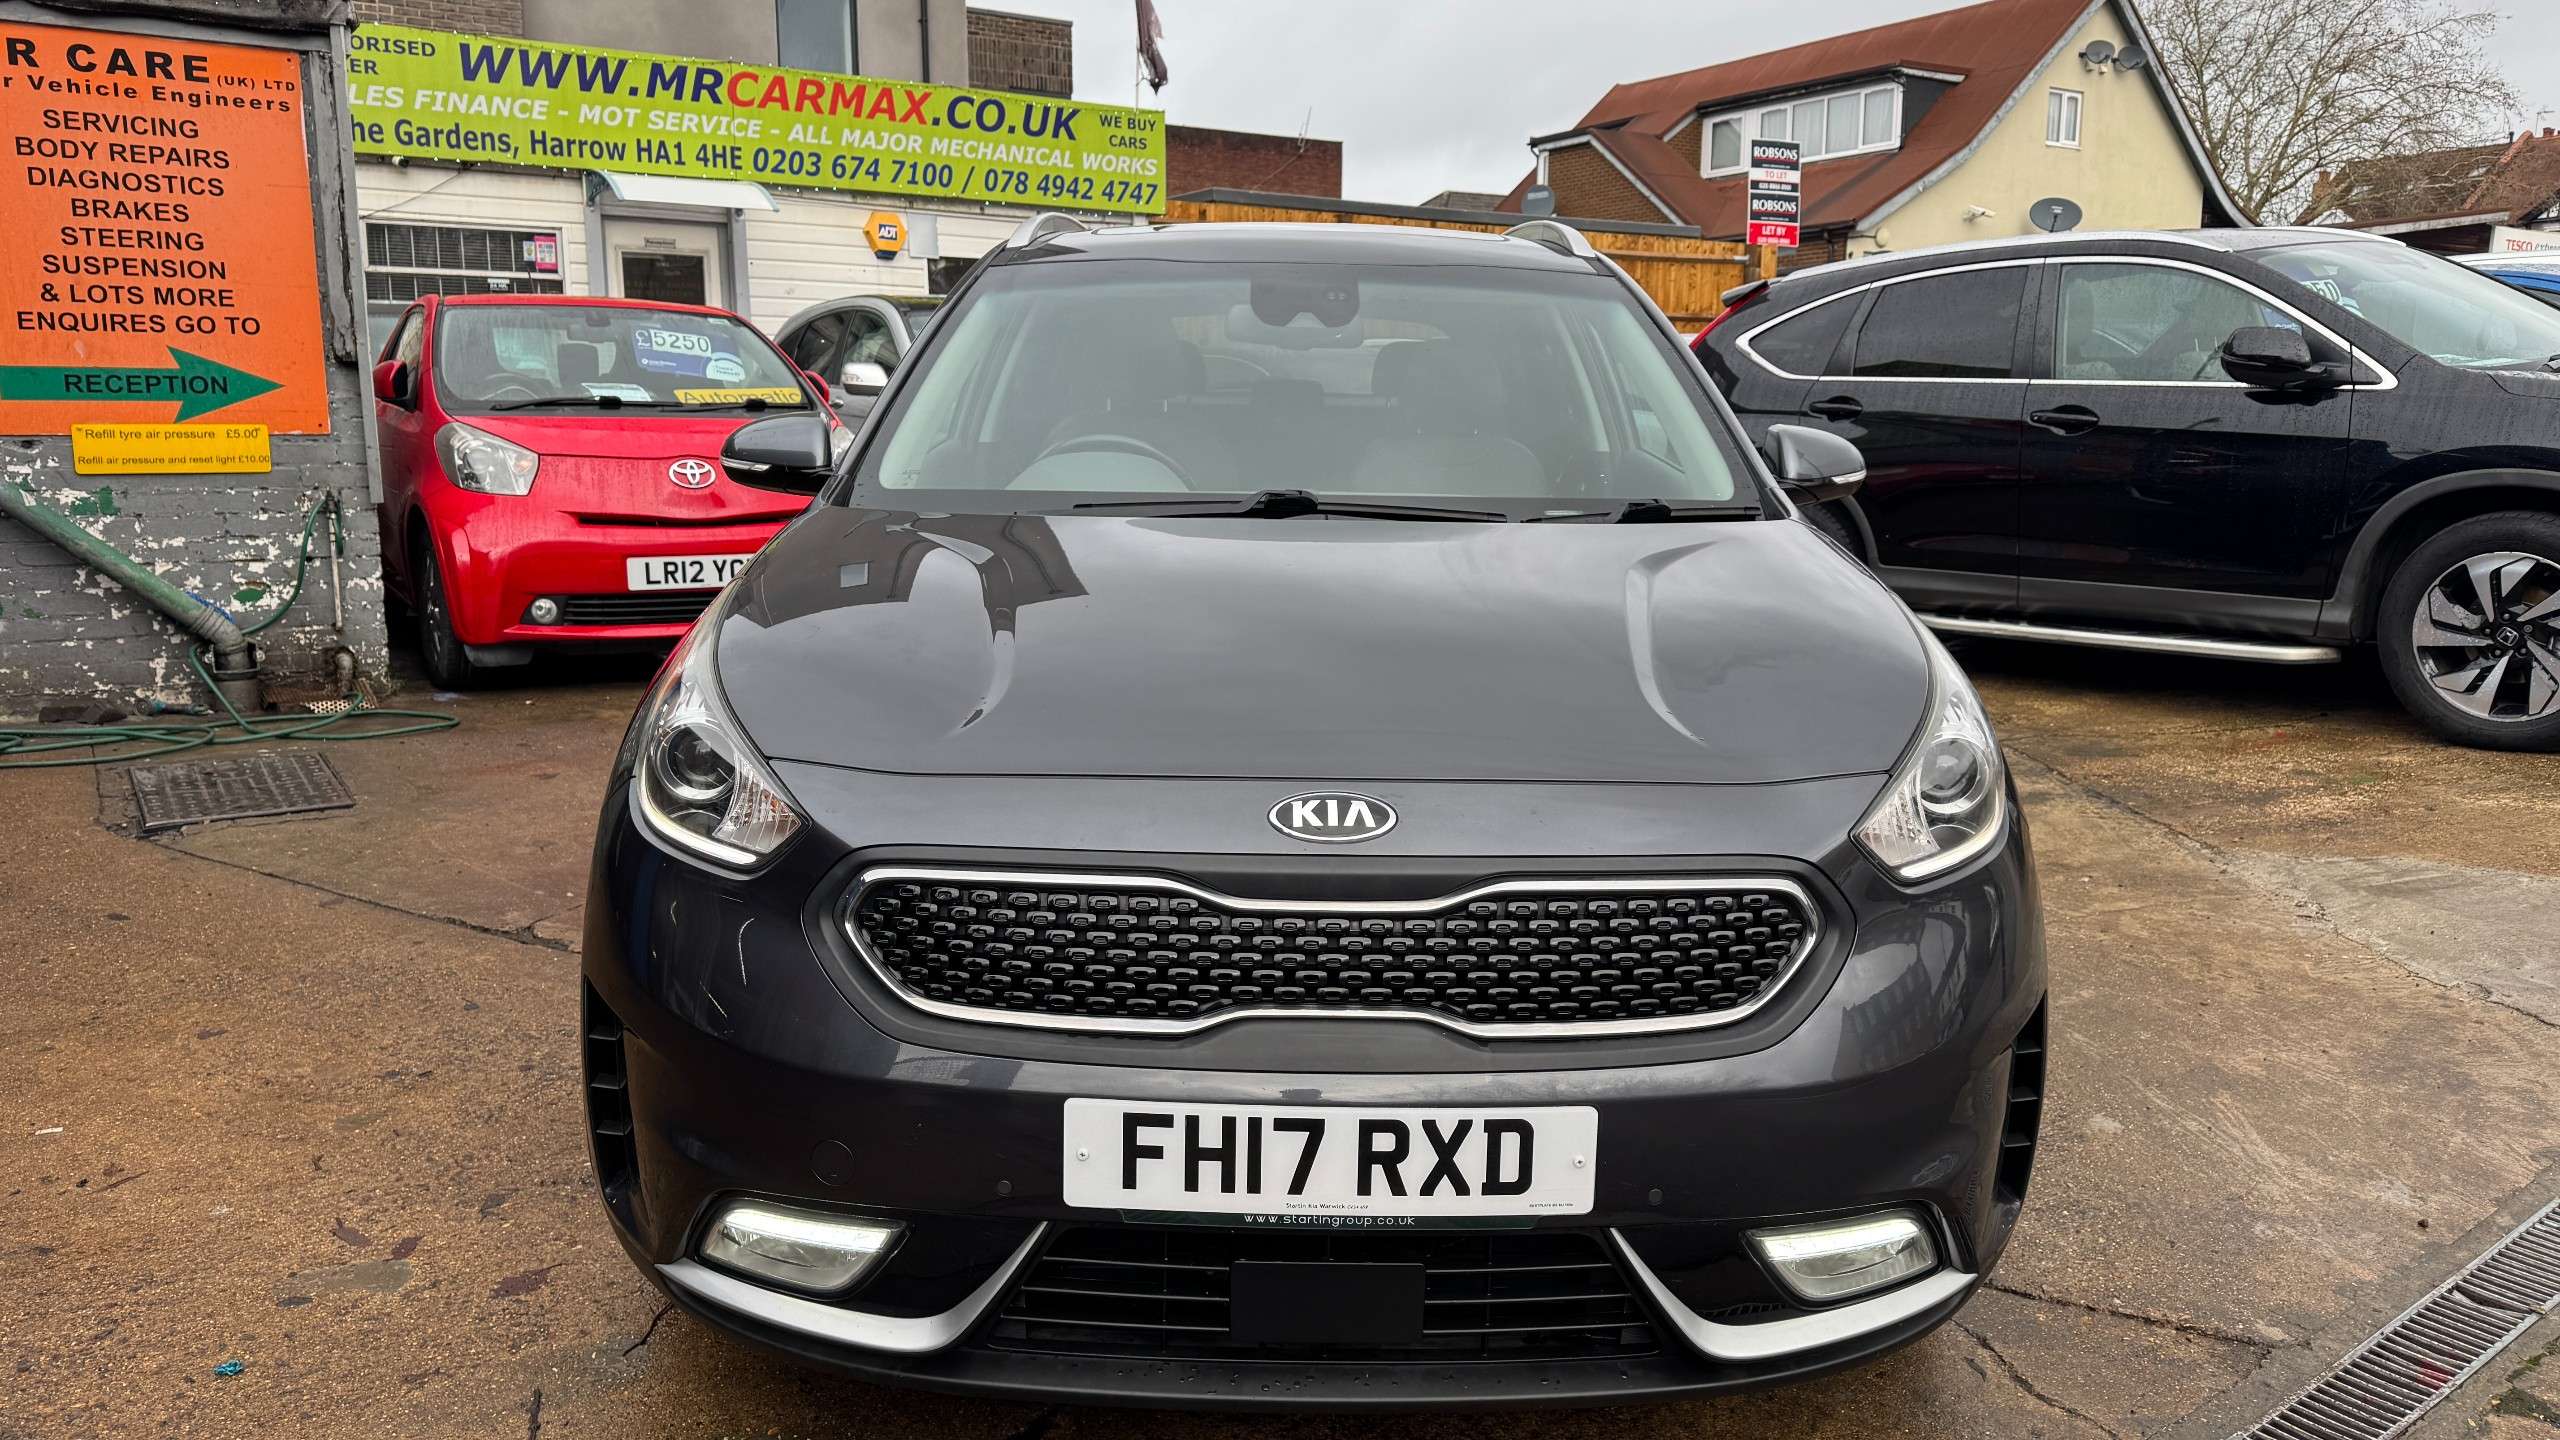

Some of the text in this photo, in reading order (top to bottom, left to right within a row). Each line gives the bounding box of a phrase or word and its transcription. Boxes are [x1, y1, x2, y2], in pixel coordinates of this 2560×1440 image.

[351, 35, 436, 57] ORISED
[66, 44, 210, 83] CARE
[216, 75, 256, 89] (UK)
[263, 79, 296, 92] LTD
[27, 74, 138, 99] Vehicle
[152, 86, 291, 113] Engineers
[458, 42, 1081, 141] WWW.MRCARMAX.CO.UK
[42, 108, 200, 139] SERVICING
[348, 83, 404, 109] LES
[414, 89, 549, 121] FINANCE
[578, 104, 641, 129] MOT
[648, 111, 762, 139] SERVICE
[788, 125, 831, 146] ALL
[841, 129, 922, 156] MAJOR
[930, 137, 1073, 169] MECHANICAL
[1082, 151, 1157, 176] WORKS
[1100, 114, 1158, 132] WE BUY
[15, 136, 231, 170] BODY REPAIRS
[1108, 134, 1147, 151] CARS
[1753, 146, 1798, 160] ROBSONS
[395, 118, 520, 159] Gardens,
[530, 130, 626, 161] Harrow
[636, 138, 685, 166] HA1
[695, 143, 742, 170] 4HE
[752, 146, 821, 177] 0203
[831, 153, 881, 182] 674
[890, 158, 953, 189] 7100
[984, 168, 1029, 195] 078
[1037, 173, 1093, 201] 4942
[1101, 179, 1158, 206] 4747
[27, 166, 225, 197] DIAGNOSTICS
[71, 198, 190, 223] BRAKES
[1752, 199, 1797, 212] ROBSONS
[60, 226, 205, 251] STEERING
[879, 226, 896, 239] ADT
[1761, 226, 1787, 236] LET BY
[2505, 239, 2533, 251] TESCO
[42, 254, 226, 280] SUSPENSION
[40, 283, 235, 308] & LOTS MORE
[16, 311, 261, 335] ENQUIRES GO TO
[63, 373, 229, 395] RECEPTION
[684, 389, 800, 404] Automatic
[85, 429, 258, 441] Refill tyre air pressure £5.00
[78, 456, 270, 466] Refill air pressure and reset light £10.00
[644, 560, 705, 585] LR12
[1290, 799, 1376, 827] KIA
[1122, 1111, 1535, 1197] FH17 RXD
[1244, 1215, 1415, 1227] www.startingroup.co.uk
